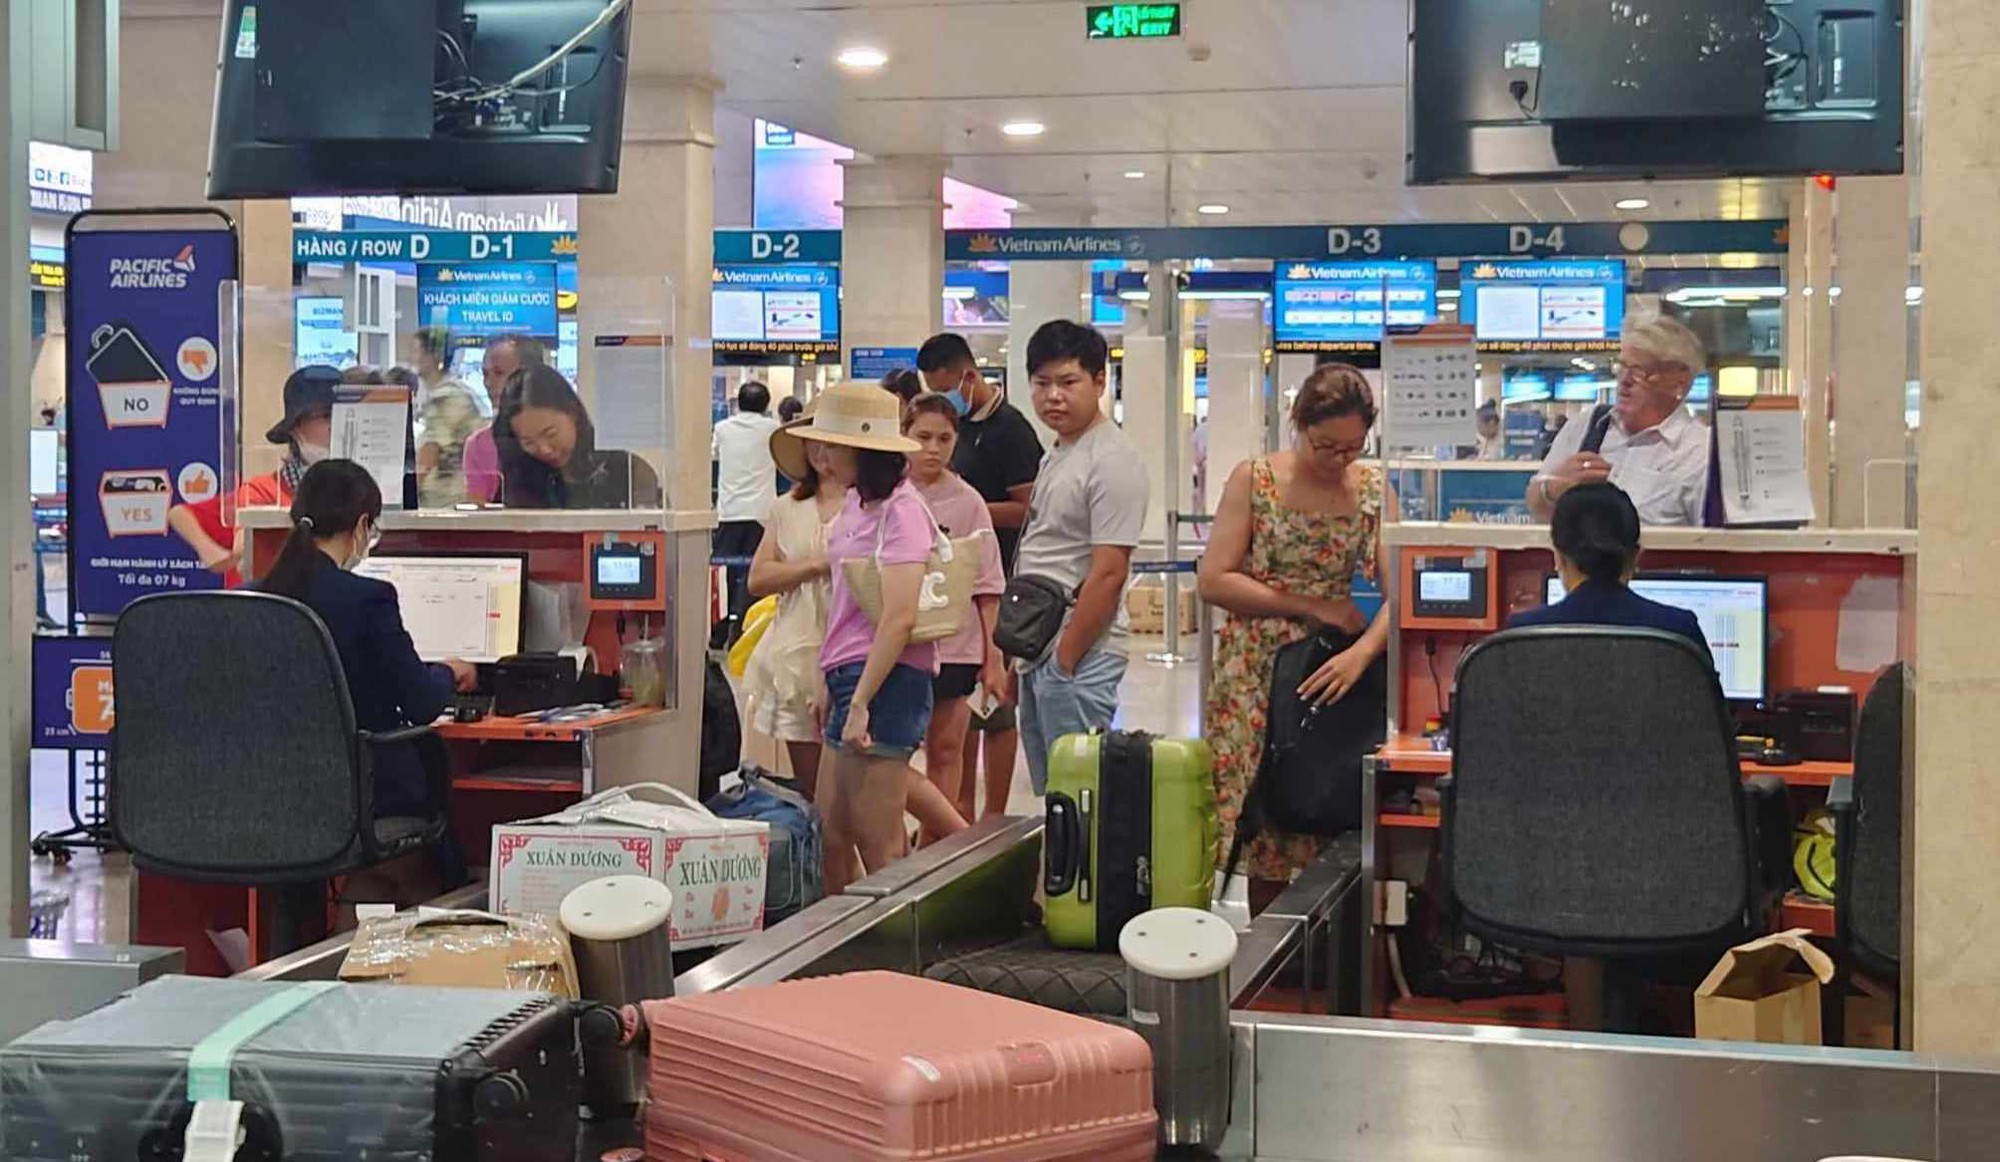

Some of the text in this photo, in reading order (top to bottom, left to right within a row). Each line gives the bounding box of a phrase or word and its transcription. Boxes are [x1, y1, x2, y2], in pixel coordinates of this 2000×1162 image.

[298, 237, 347, 256] HÀNG
[362, 239, 402, 256] ROW
[411, 234, 430, 259] D
[470, 235, 514, 259] D-1
[752, 233, 800, 259] D-2
[999, 235, 1121, 253] Vietnam Airlines
[1328, 228, 1382, 254] D-3
[1509, 226, 1565, 253] D-4
[110, 258, 173, 273] PACIFIC
[110, 273, 187, 288] AIRLINES
[424, 291, 461, 305] KHÁCH
[461, 310, 514, 323] TRAVEL ID
[124, 398, 149, 411] NO
[121, 507, 152, 521] YES
[118, 572, 186, 588] Tối đa 07 kg
[526, 849, 623, 868] XUÂN DƯƠNG
[679, 852, 762, 887] XUÂN DƯƠNG
